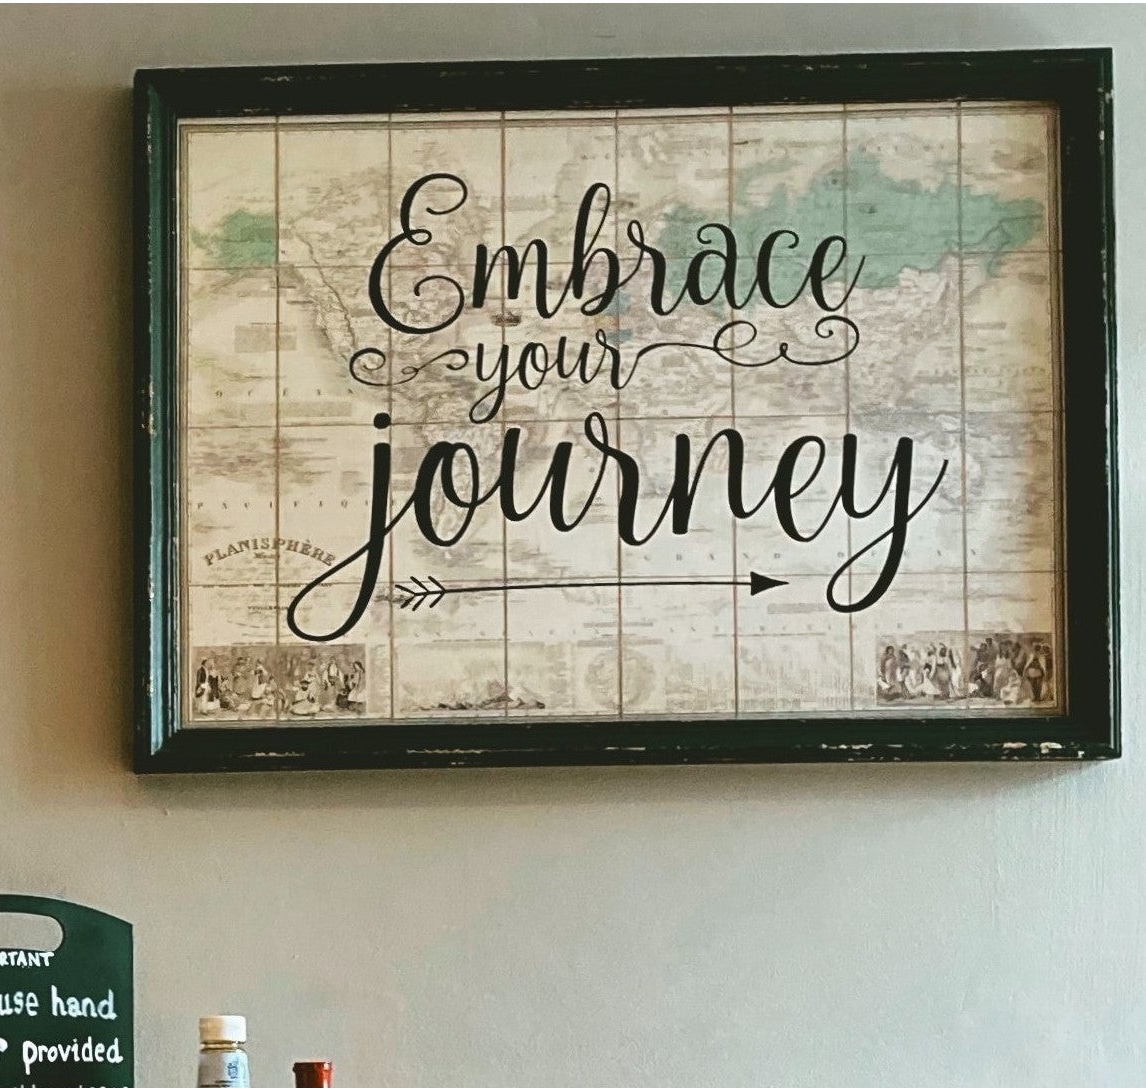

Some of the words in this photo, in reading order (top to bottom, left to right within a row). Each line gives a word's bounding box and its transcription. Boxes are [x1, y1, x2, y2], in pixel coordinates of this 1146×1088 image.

[368, 173, 866, 334] Embrace
[469, 328, 639, 424] your
[204, 537, 336, 566] PLANISPHÈRE
[286, 411, 950, 642] journey
[51, 985, 117, 1020] hand
[22, 1036, 123, 1075] provided
